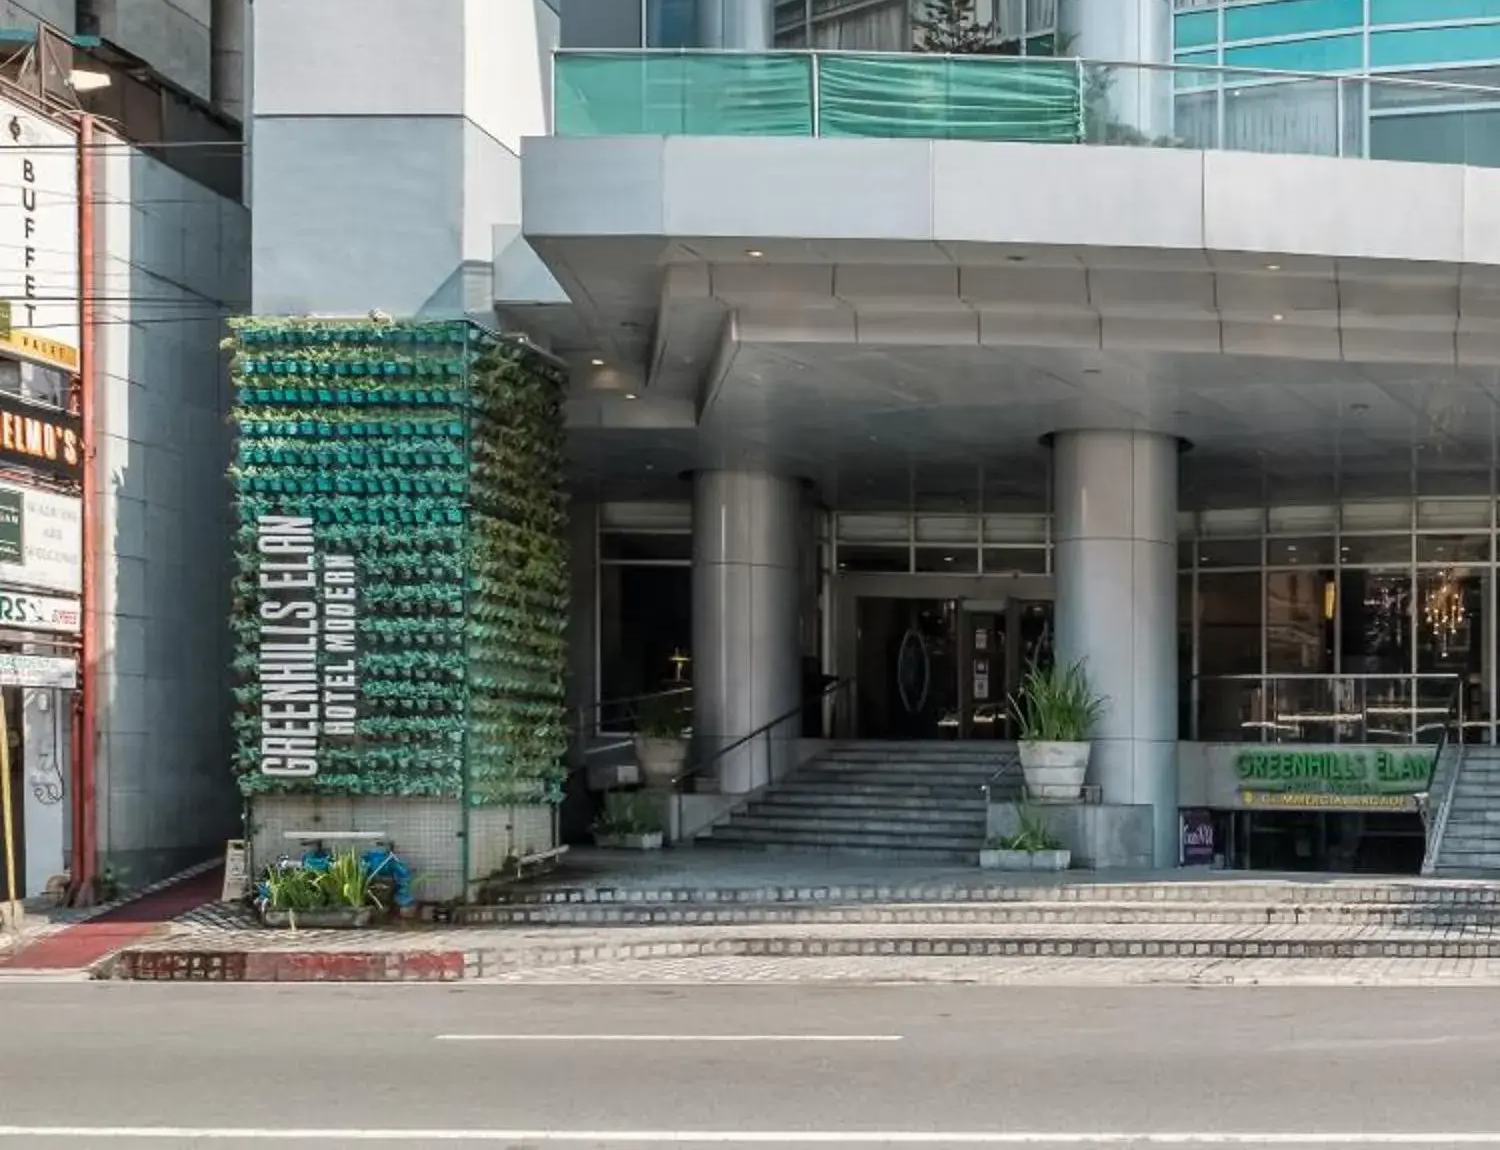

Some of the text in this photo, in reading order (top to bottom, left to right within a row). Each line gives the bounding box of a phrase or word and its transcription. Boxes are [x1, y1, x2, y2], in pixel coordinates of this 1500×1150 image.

[22, 159, 37, 327] BUFFET
[257, 515, 319, 777] GREENHILLS ELAN
[323, 554, 357, 735] HOTEL MODERN
[1237, 751, 1367, 781] GREENHILLS
